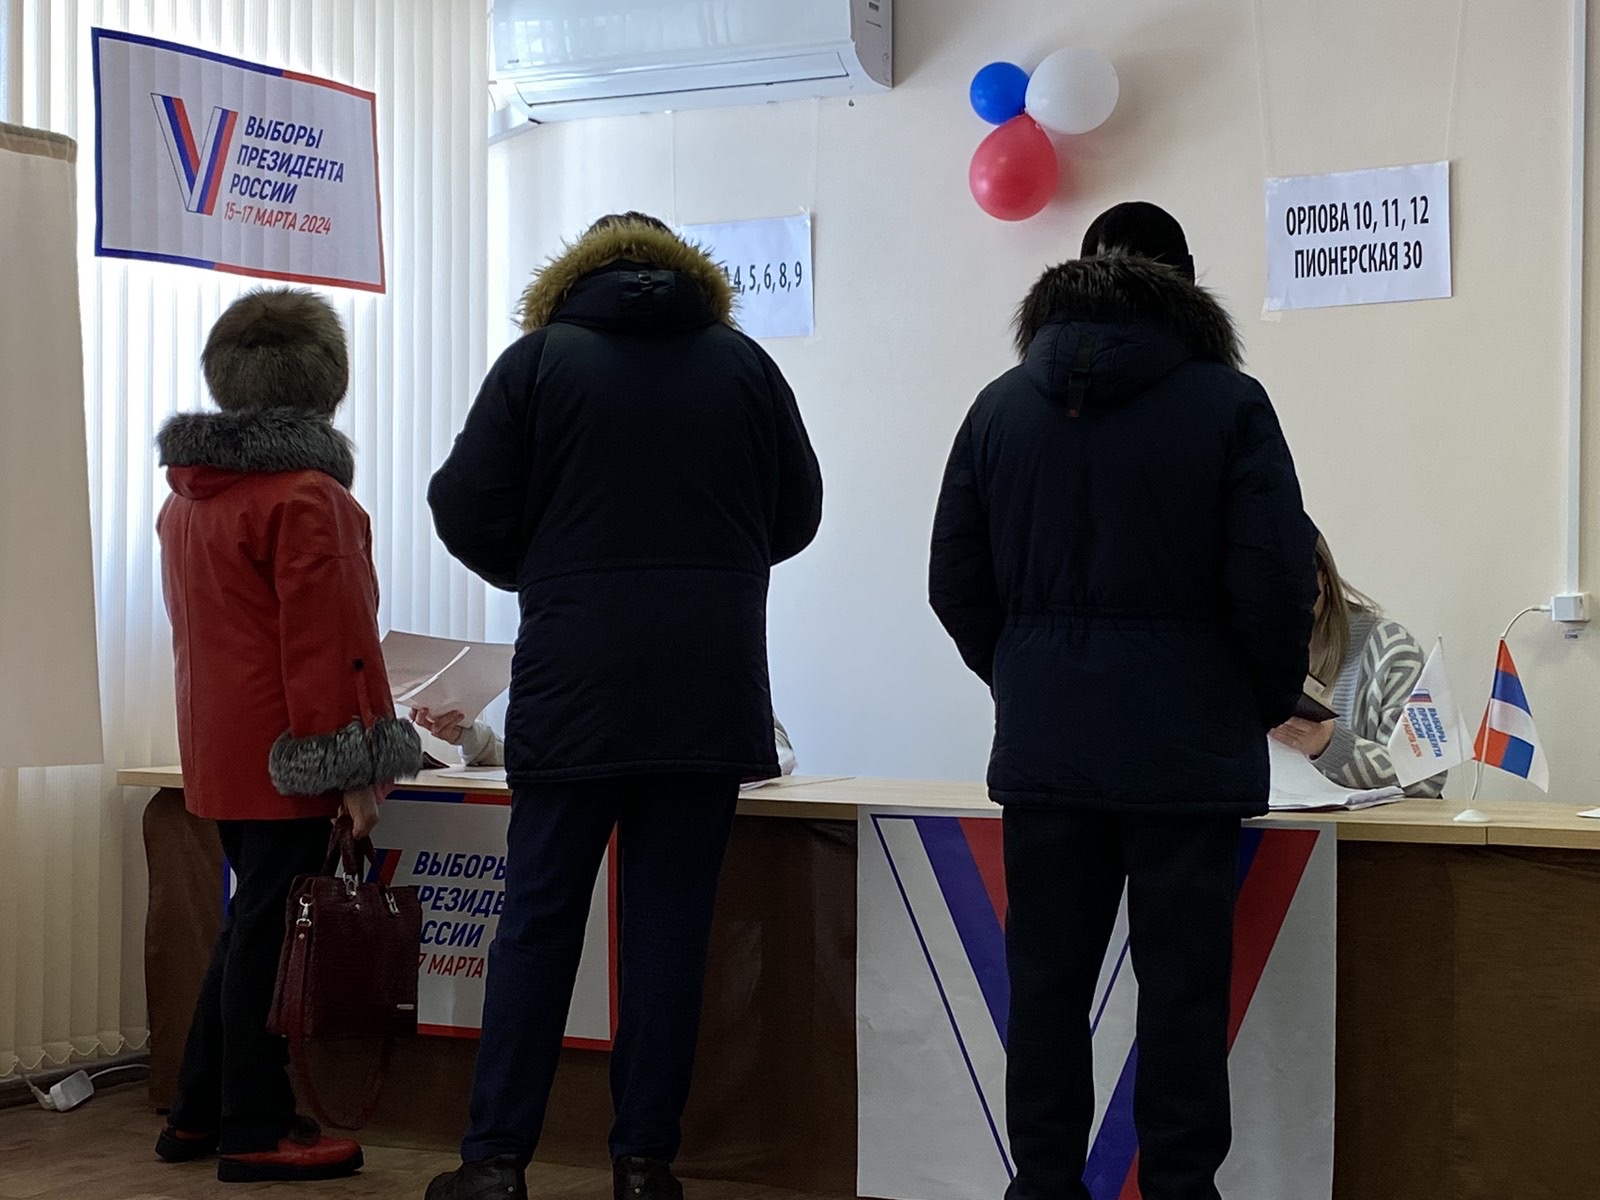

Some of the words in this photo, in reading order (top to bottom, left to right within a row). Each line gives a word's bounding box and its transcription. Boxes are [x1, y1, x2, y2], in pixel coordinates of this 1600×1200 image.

[244, 115, 324, 150] ВЫБОРЫ
[236, 144, 345, 183] ПРЕЗИДЕНТА
[229, 173, 298, 205] РОССИИ
[253, 207, 298, 231] МАРТА
[299, 213, 332, 236] 2024
[1286, 202, 1350, 236] ОРЛОВА
[1353, 200, 1378, 234] 10,
[1382, 198, 1406, 232] 11,
[1410, 195, 1430, 225] 12
[794, 260, 802, 288] 9
[1294, 241, 1399, 279] ПИОНЕРСКАЯ
[1403, 240, 1423, 270] 30
[1406, 707, 1426, 739] РОССИИ
[1416, 707, 1443, 758] ПРЕЗИДЕНТА
[1427, 707, 1448, 743] ВЫБОРЫ
[420, 920, 486, 948] ССИИ
[427, 953, 485, 978] МАРТА
